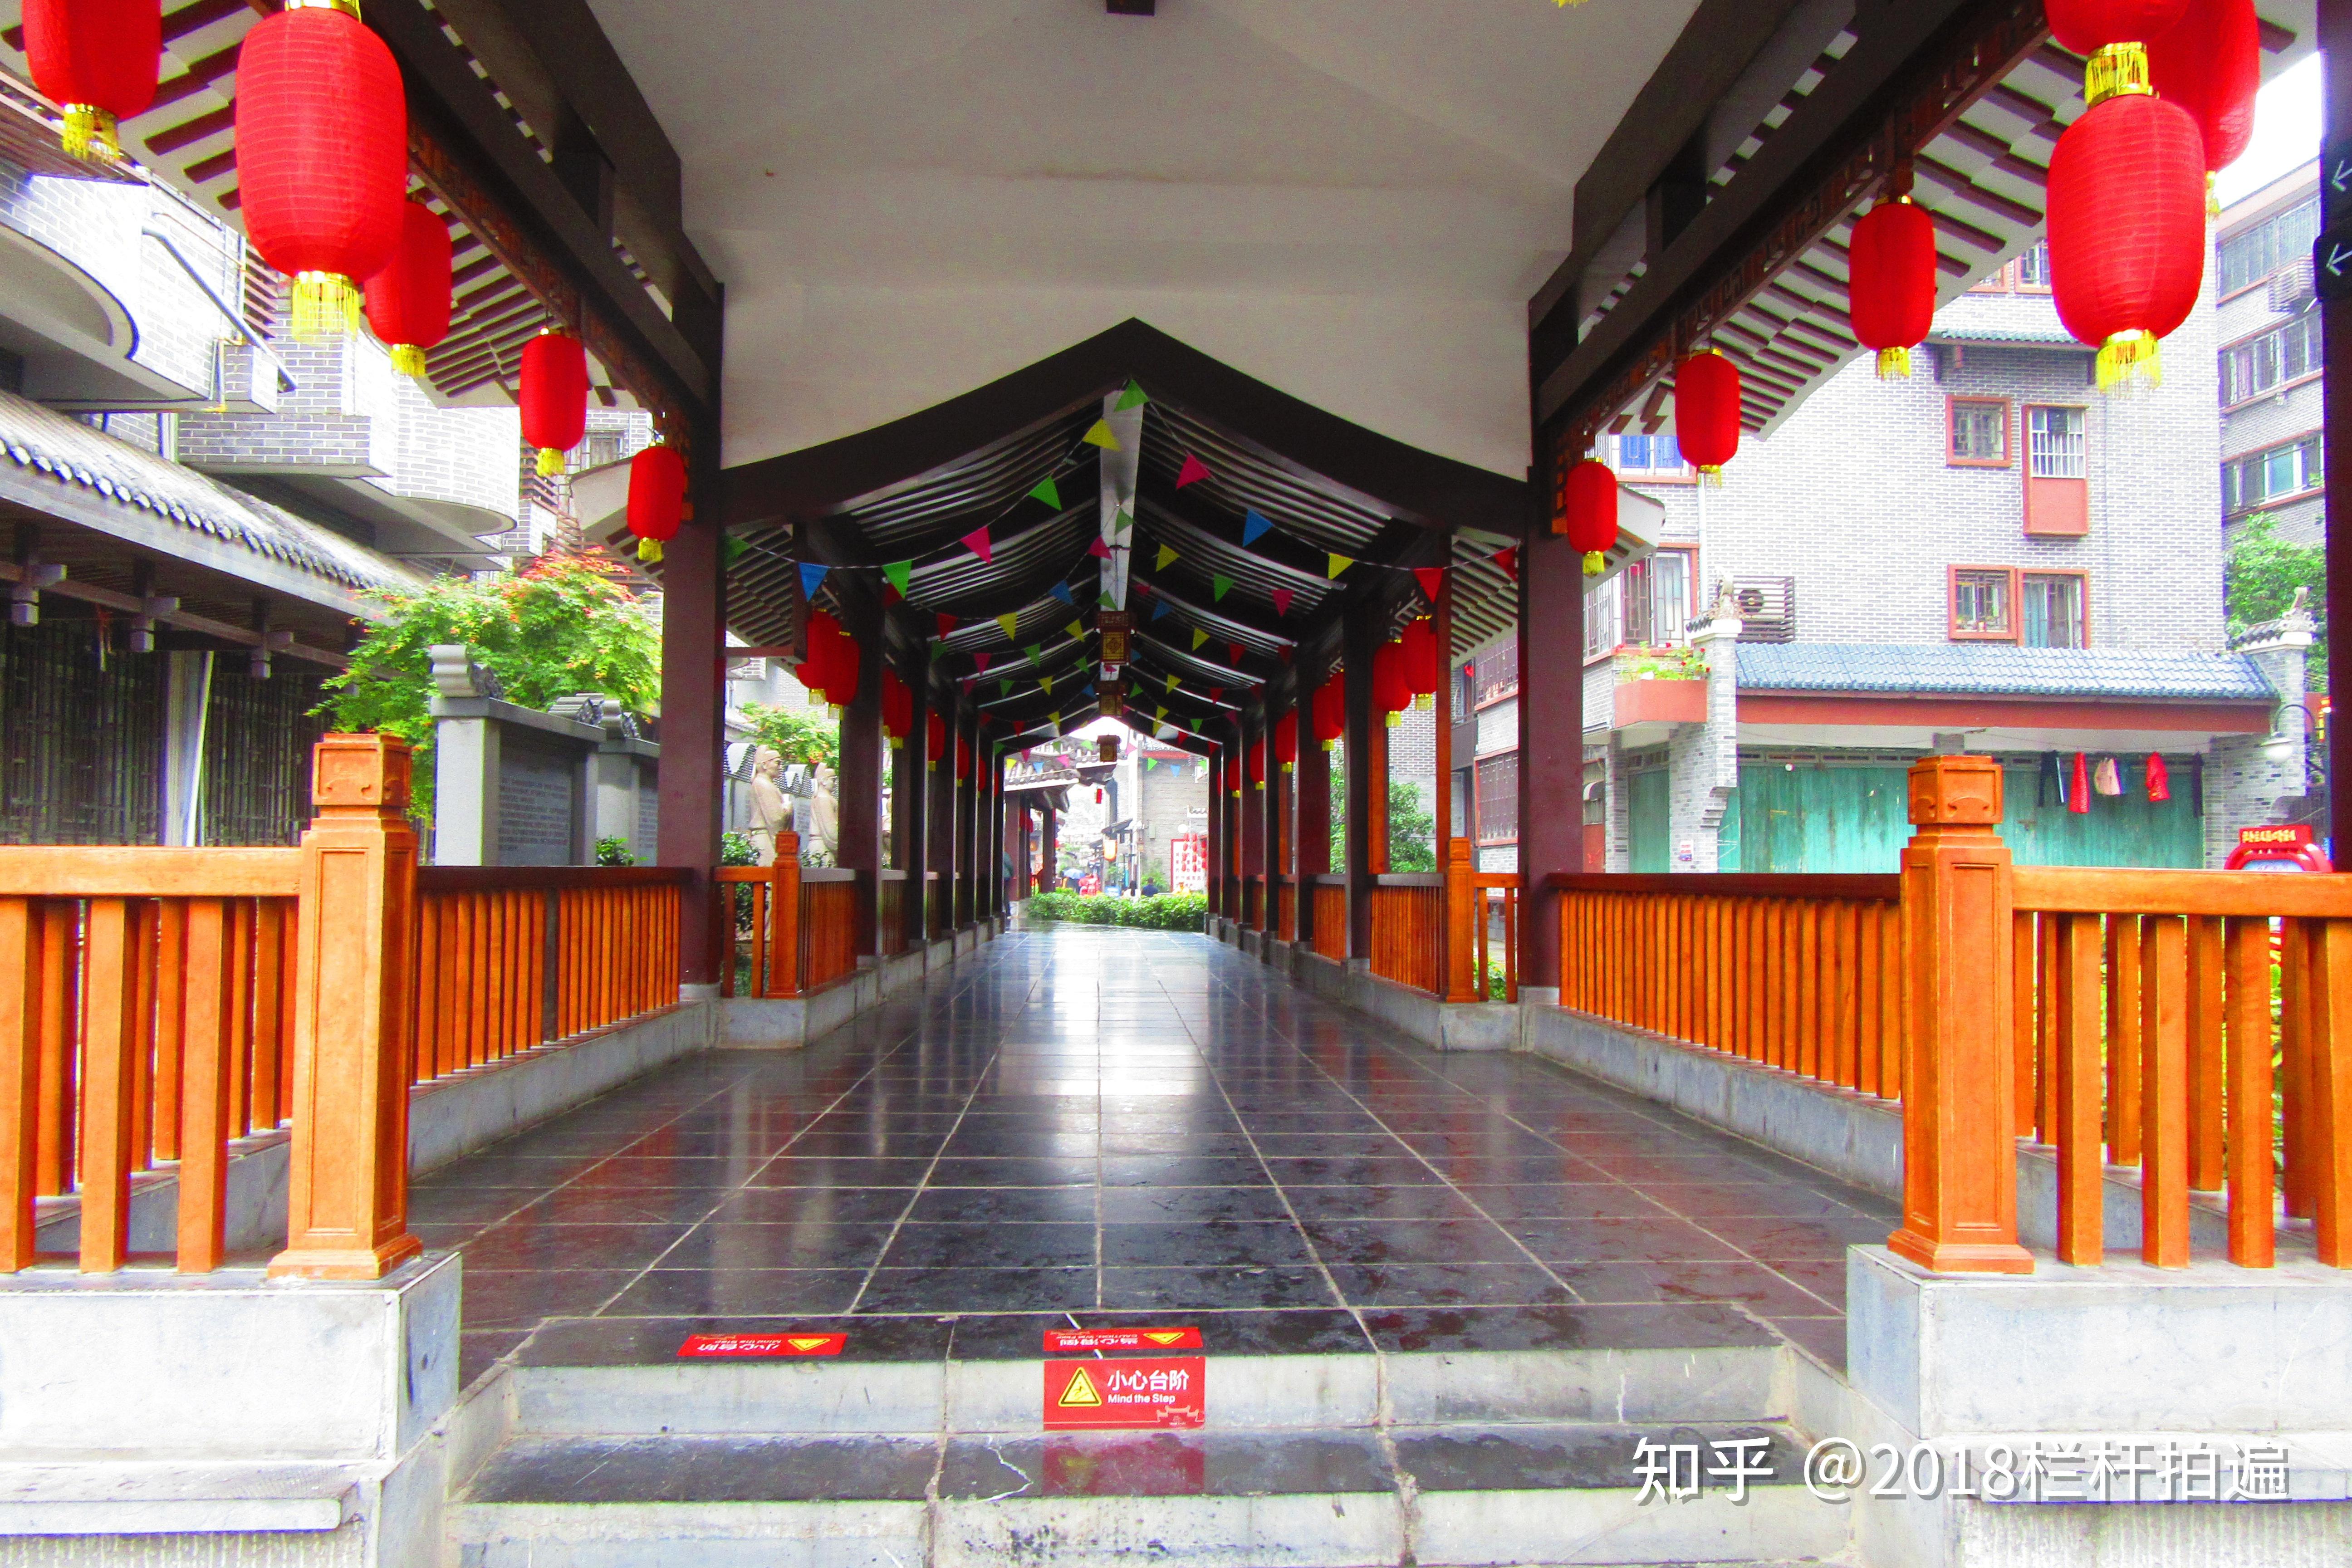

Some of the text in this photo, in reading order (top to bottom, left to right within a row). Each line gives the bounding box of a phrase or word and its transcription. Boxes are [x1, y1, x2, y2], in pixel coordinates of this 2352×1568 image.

[1107, 1369, 1189, 1391] 小心台阶
[1107, 1393, 1176, 1405] Mind the Step
